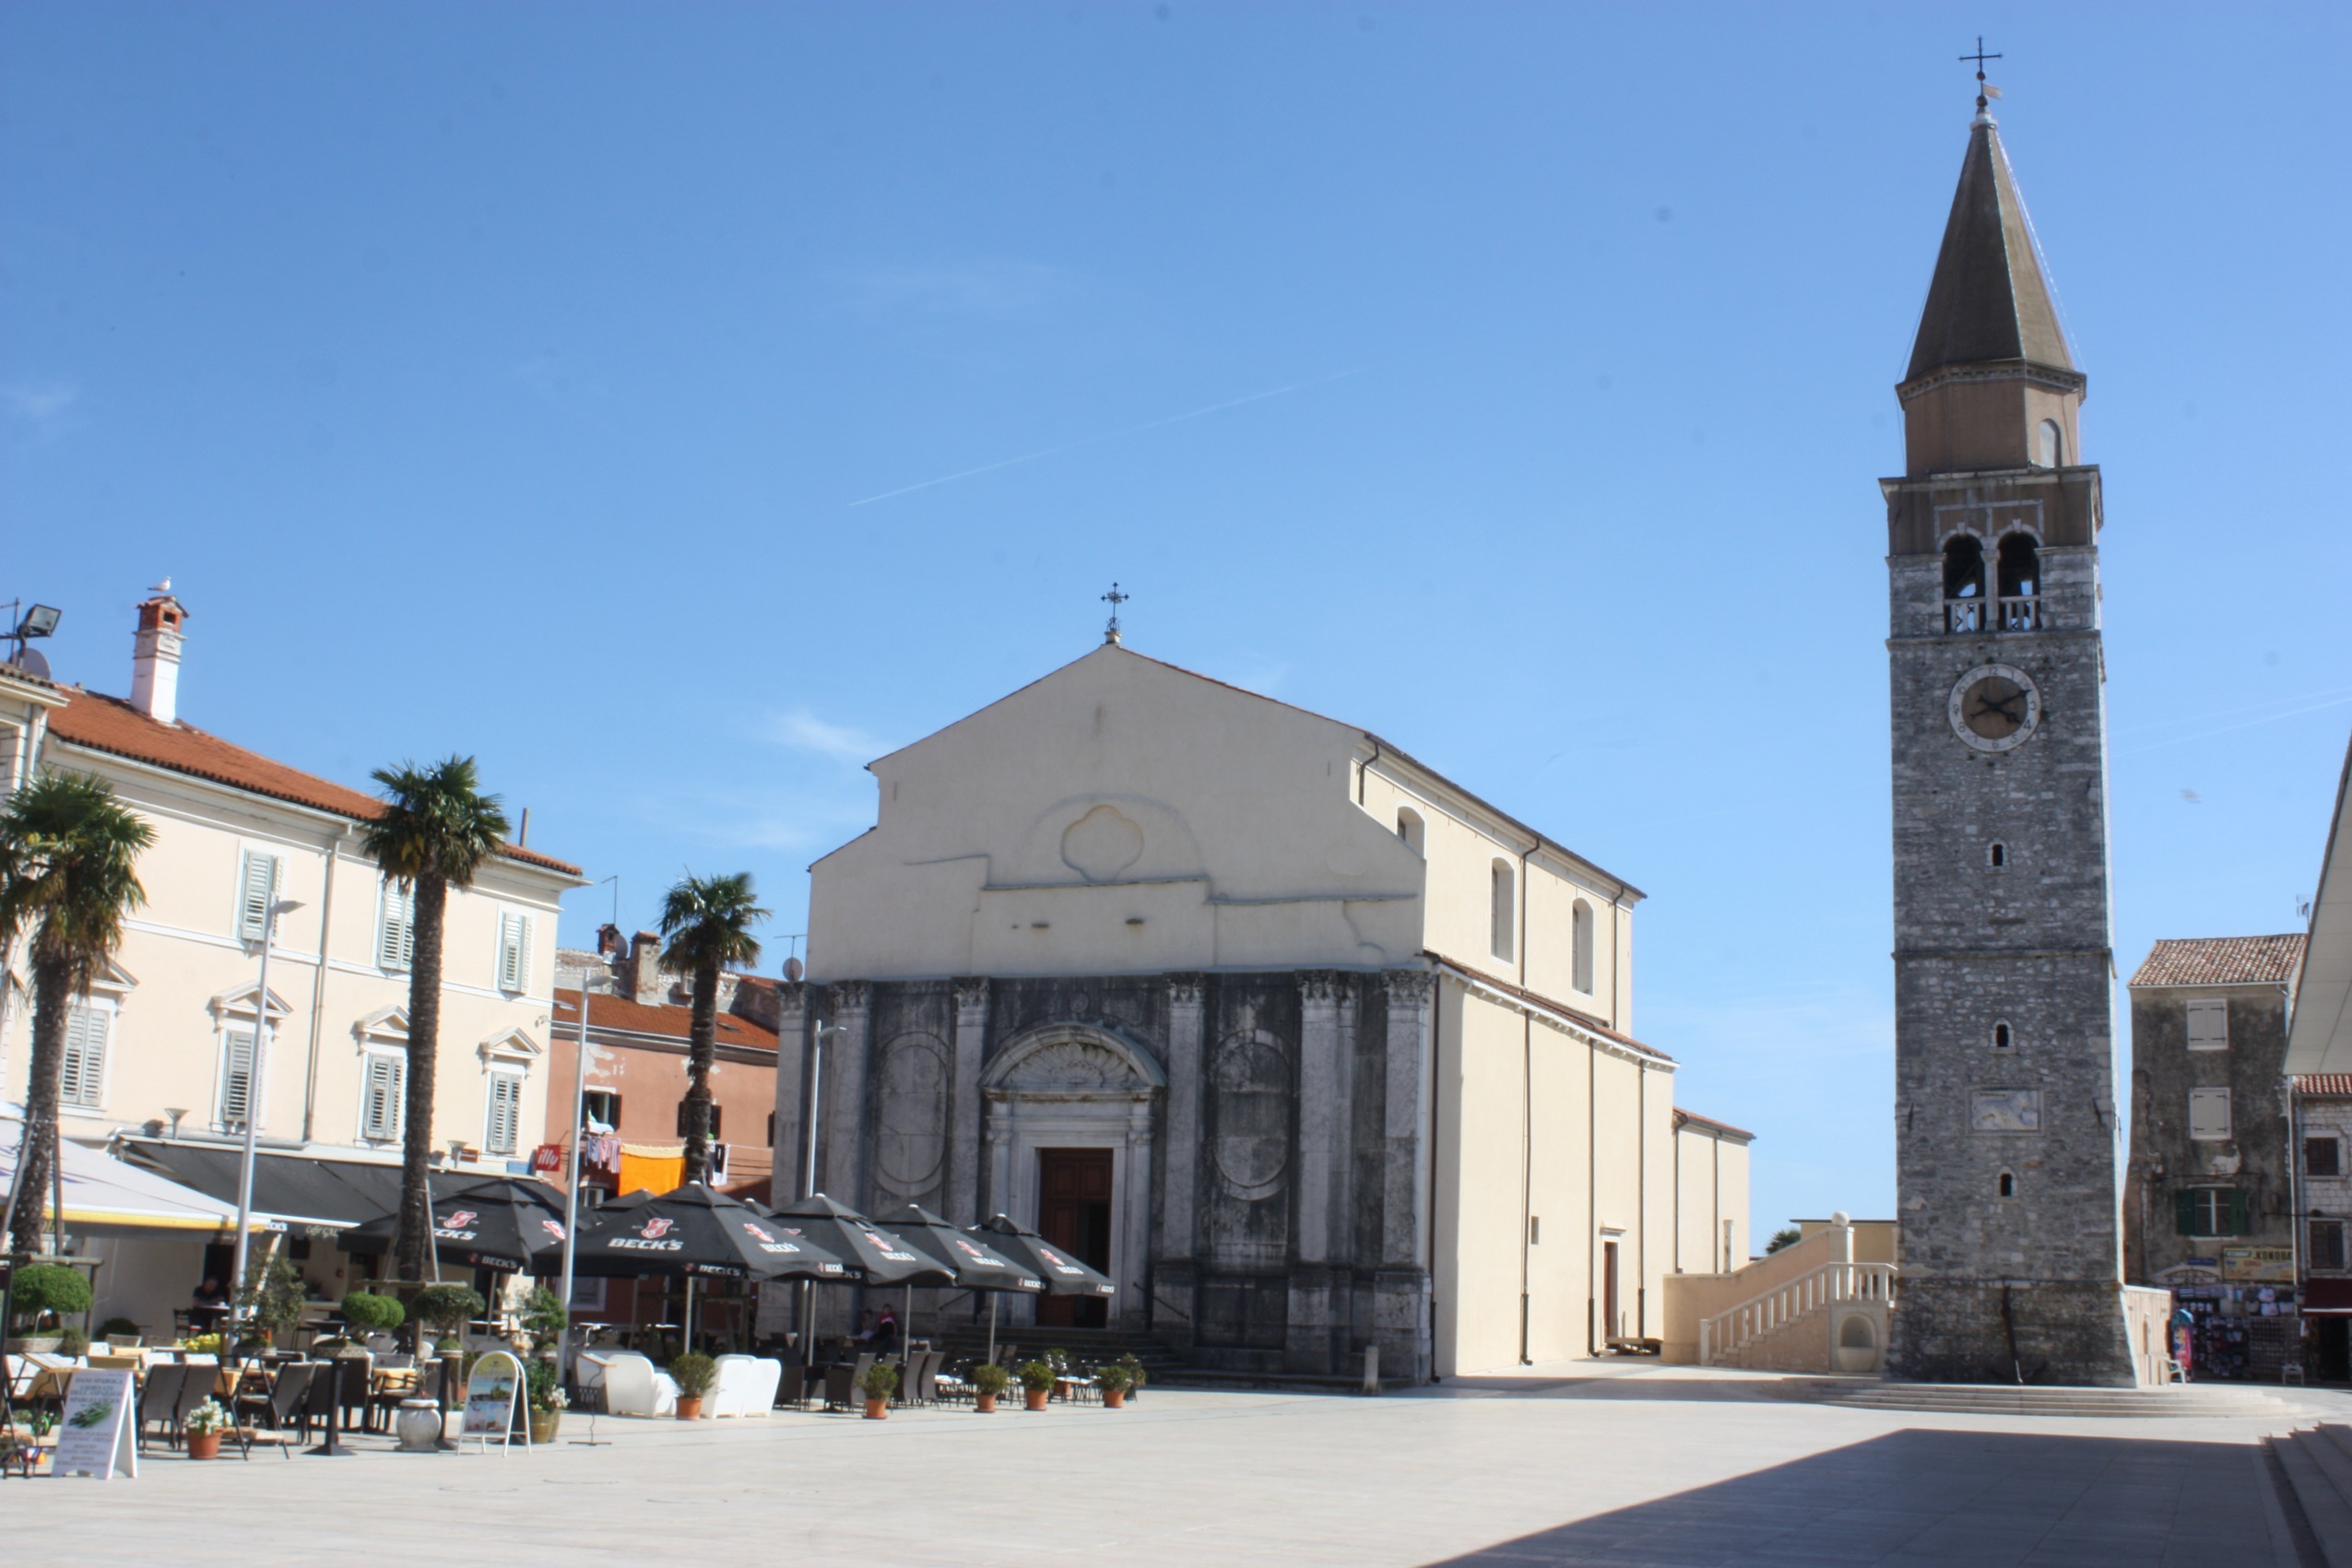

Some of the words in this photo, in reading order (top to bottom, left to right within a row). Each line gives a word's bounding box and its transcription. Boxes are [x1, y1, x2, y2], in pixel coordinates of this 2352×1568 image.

[2029, 701, 2036, 711] 3
[1958, 722, 1965, 732] 8
[2023, 719, 2031, 729] 4
[538, 1148, 559, 1169] illy
[608, 1238, 684, 1251] BECK'S
[759, 1242, 800, 1253] BECK'S
[481, 1256, 518, 1269] BECK'S
[699, 1264, 742, 1277] BECK'S
